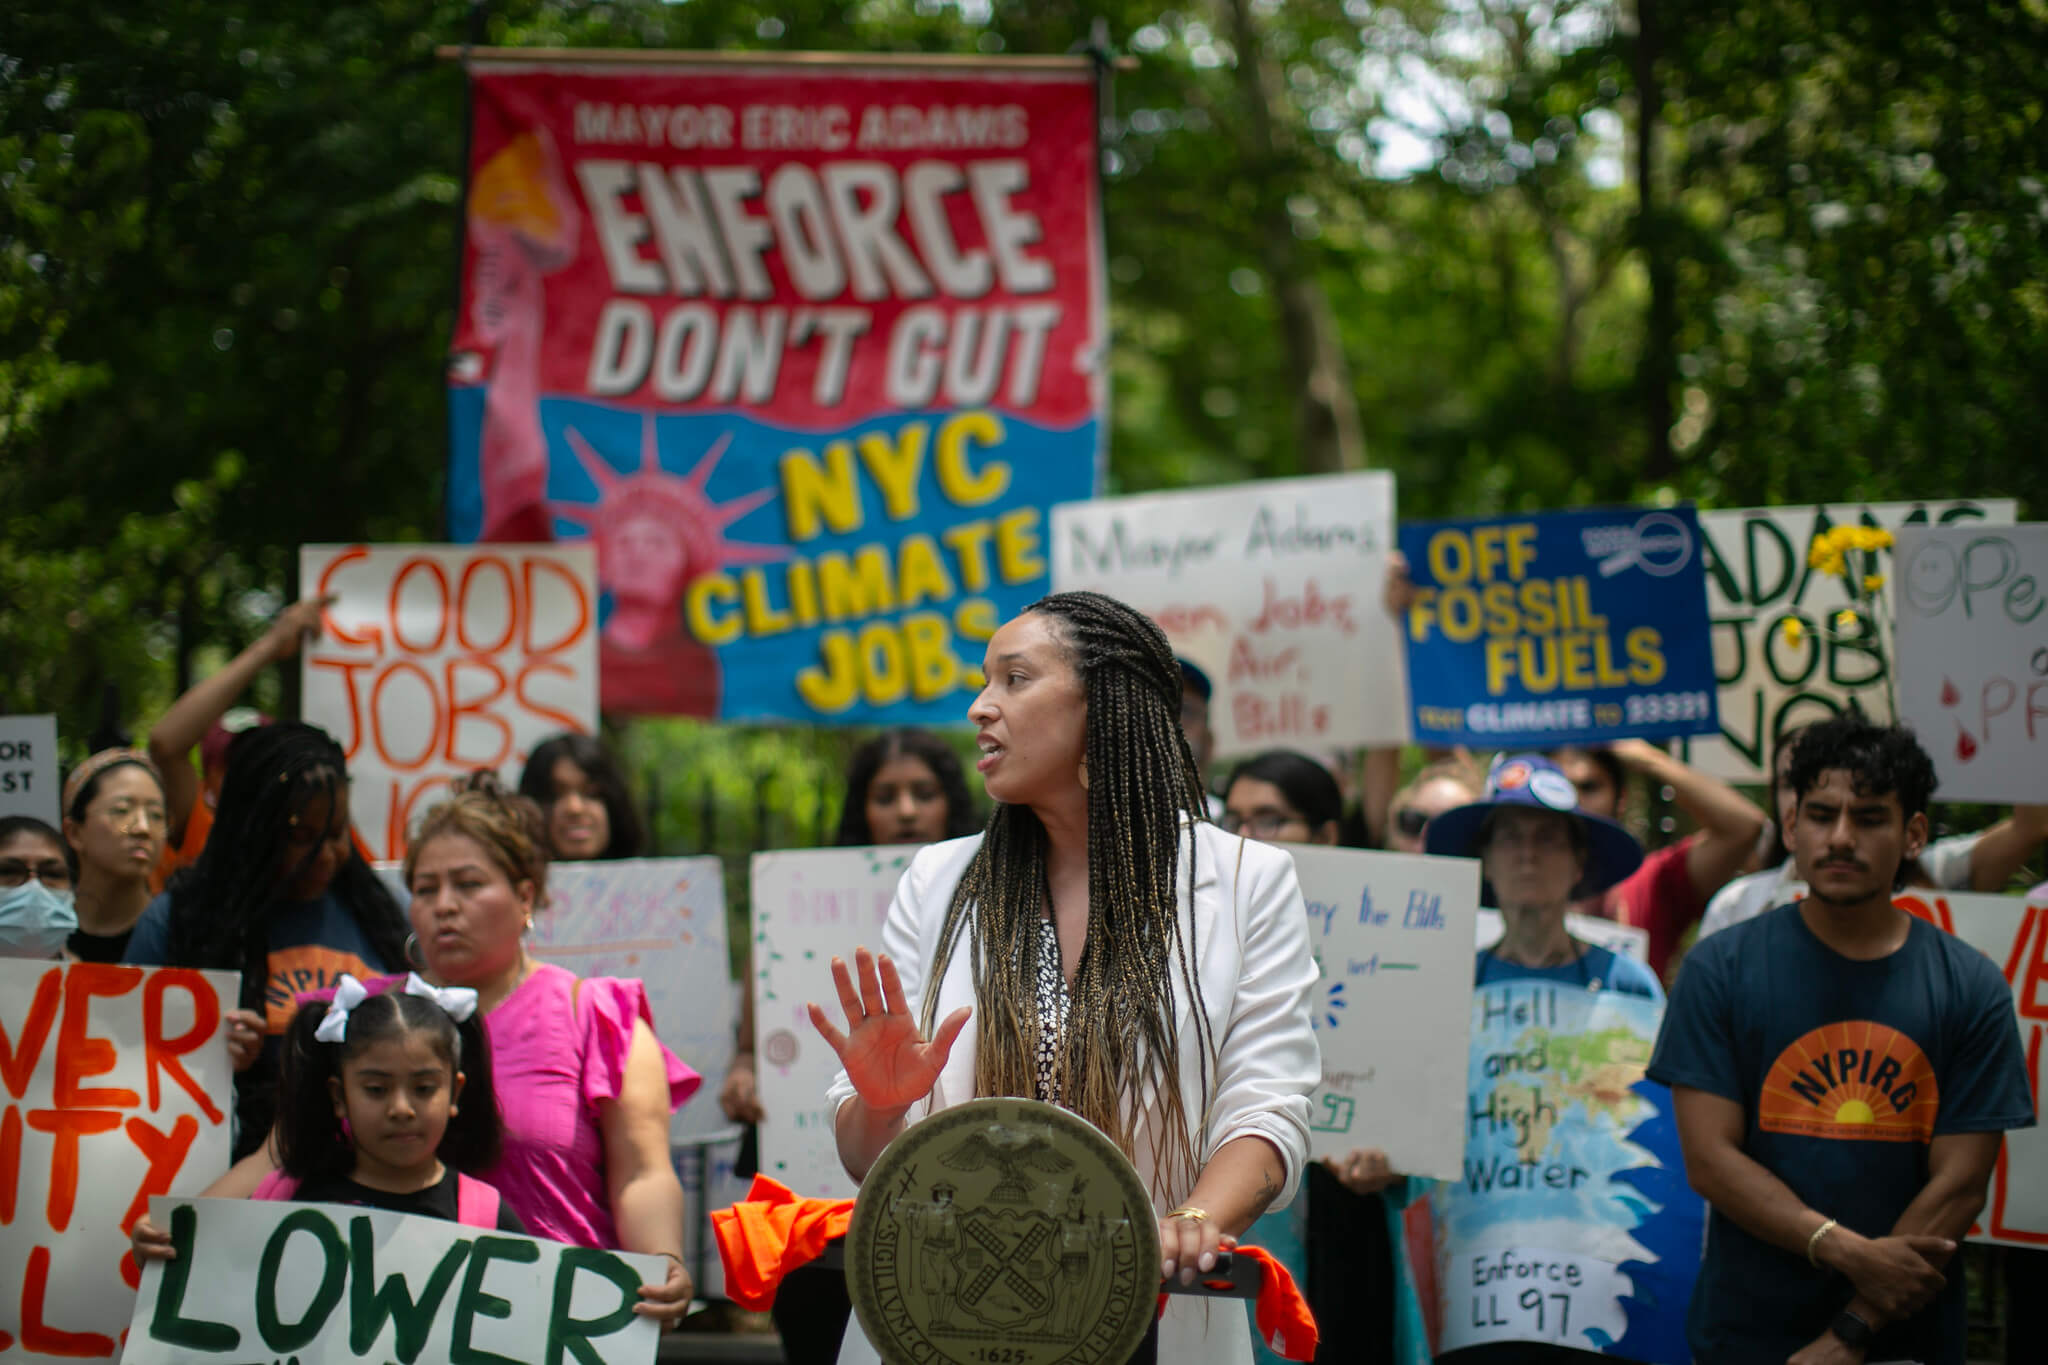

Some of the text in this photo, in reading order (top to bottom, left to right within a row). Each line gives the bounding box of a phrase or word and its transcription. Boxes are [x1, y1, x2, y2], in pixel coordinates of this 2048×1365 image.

[573, 105, 1029, 151] MAYOR ERIC ADAMS
[575, 160, 1056, 301] ENFORCE
[589, 301, 1063, 408] DON'T GUT
[781, 410, 1012, 541] NYC
[1071, 503, 1378, 579] Mayor Adams
[1427, 522, 1537, 587] OFF
[317, 544, 591, 658] GOOD
[685, 507, 1046, 645] CLIMATE
[1409, 574, 1609, 643] FOSSIL
[1485, 626, 1667, 696] FUELS
[1465, 699, 1592, 734] CLIMATE
[1482, 985, 1557, 1031] Hell
[1482, 1040, 1549, 1080] and
[1790, 1048, 1918, 1115] NYPIRG
[1469, 1087, 1559, 1150] High
[1465, 1149, 1590, 1194] Water
[150, 1204, 645, 1365] LOWER
[1471, 1250, 1583, 1288] Enforce
[1471, 1287, 1571, 1337] LL 97
